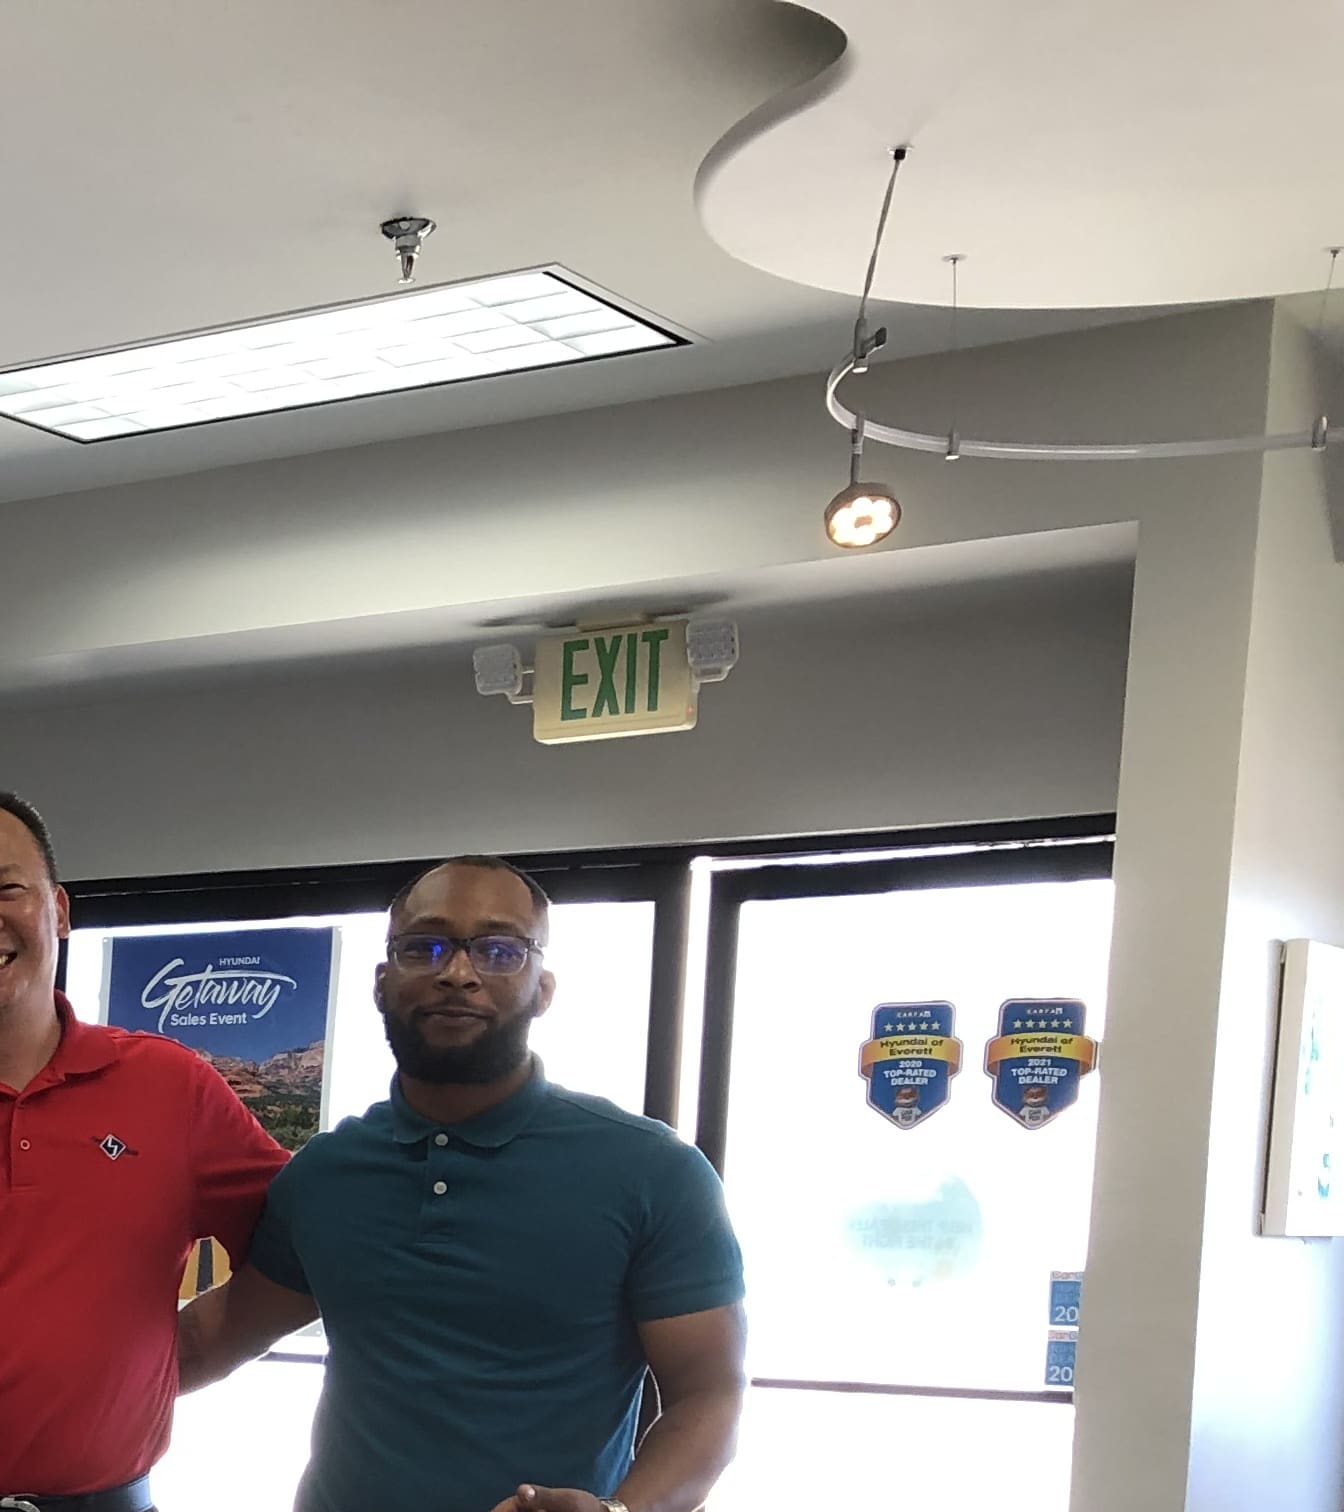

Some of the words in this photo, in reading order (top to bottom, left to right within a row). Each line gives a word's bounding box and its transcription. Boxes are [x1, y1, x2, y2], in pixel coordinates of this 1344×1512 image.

[560, 628, 669, 721] EXIT
[219, 956, 260, 967] HYUNDAI
[141, 957, 297, 1034] Getaway
[170, 1013, 207, 1027] Sales
[209, 1012, 248, 1026] Event
[880, 1037, 928, 1049] Hyundai
[930, 1038, 944, 1047] of
[1010, 1034, 1058, 1046] Hyundai
[889, 1047, 933, 1057] Everett
[1019, 1045, 1062, 1054] Everett
[898, 1060, 923, 1069] 2020
[1027, 1058, 1052, 1067] 2021
[883, 1068, 937, 1079] TOP-RATED
[1011, 1067, 1068, 1077] TOP-RATED
[891, 1077, 929, 1086] DEALER
[1018, 1076, 1059, 1085] DEALER
